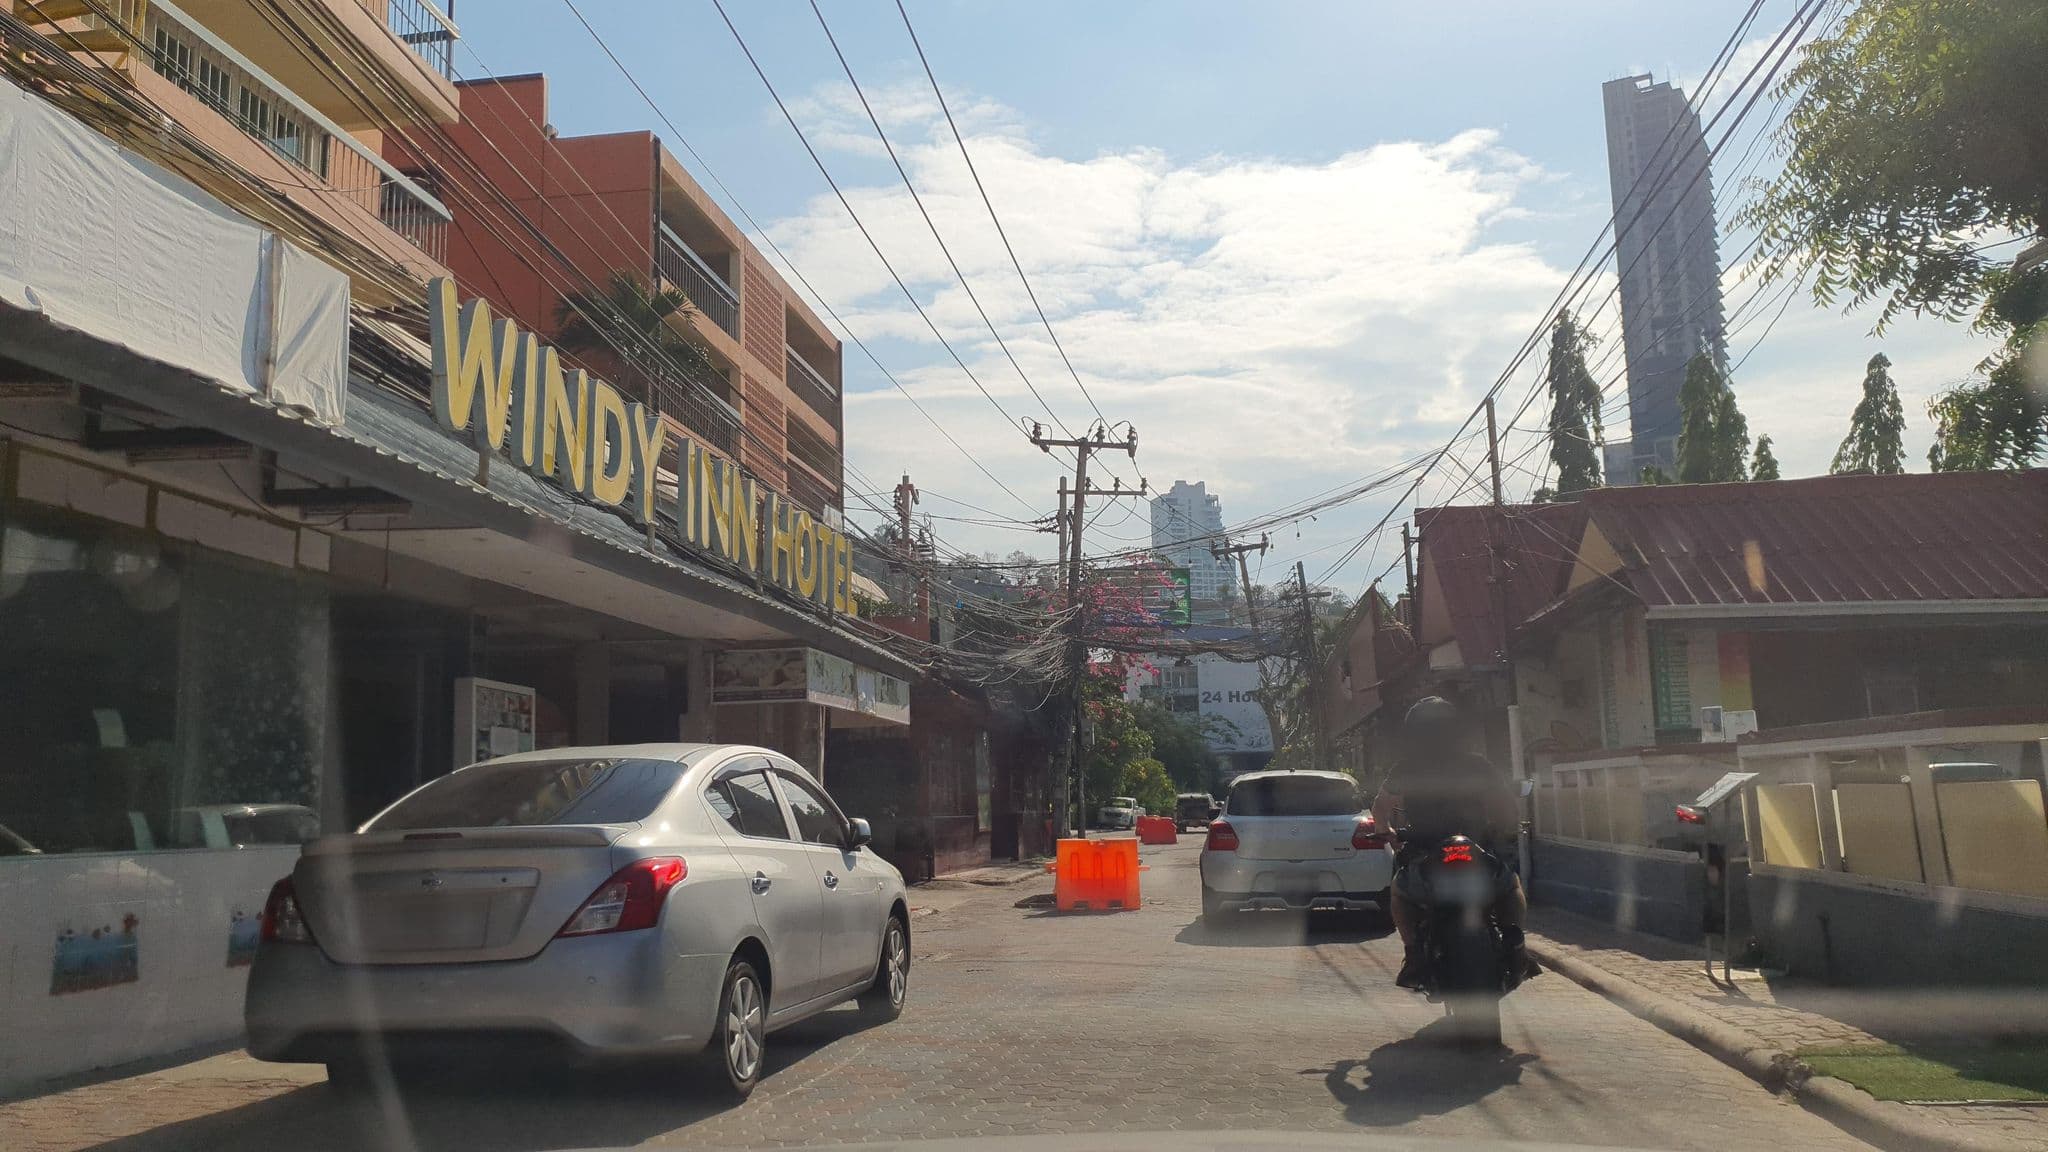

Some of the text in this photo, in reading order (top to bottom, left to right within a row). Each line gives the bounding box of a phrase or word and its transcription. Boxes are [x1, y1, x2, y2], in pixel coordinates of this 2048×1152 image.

[431, 277, 858, 616] WINDY INN HOTEL
[1201, 690, 1222, 704] 24
